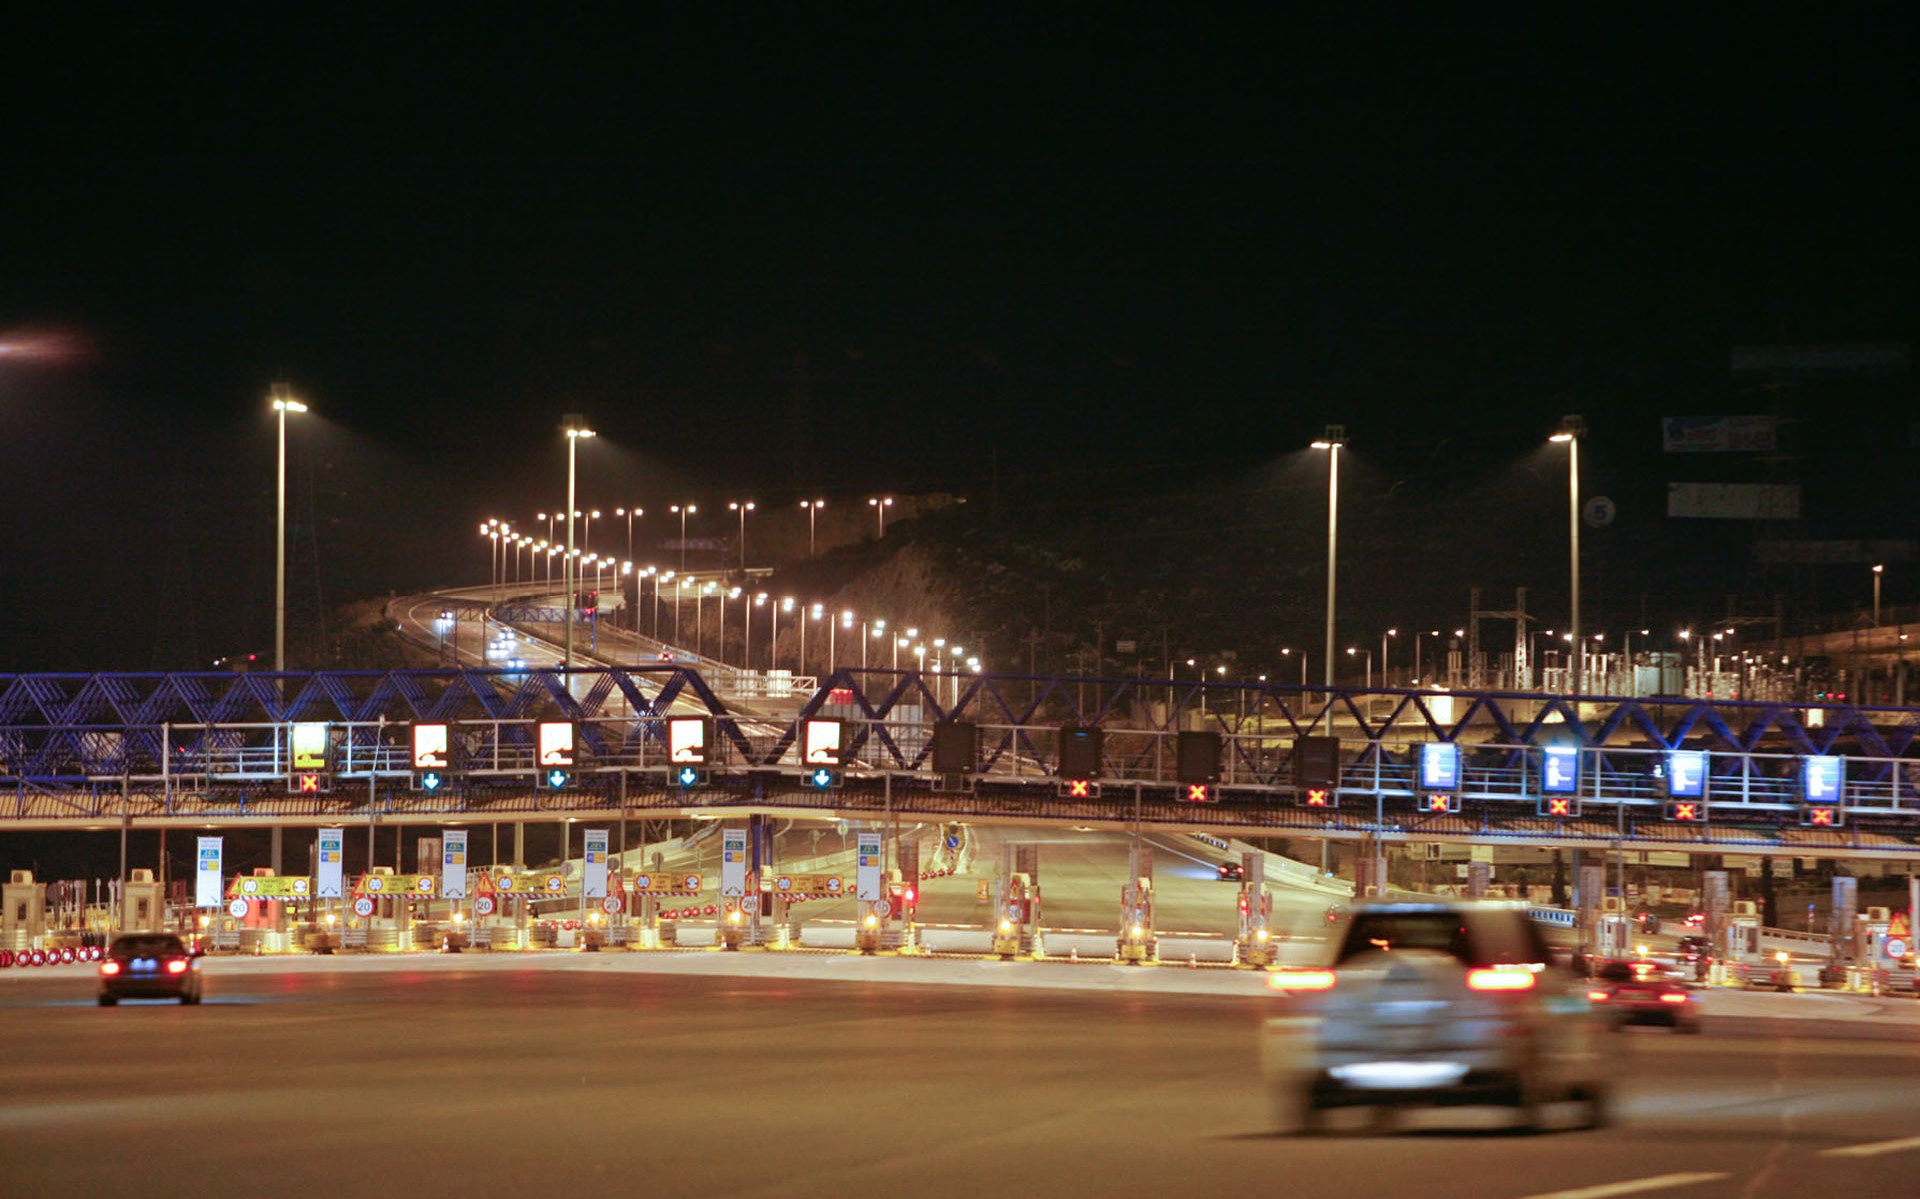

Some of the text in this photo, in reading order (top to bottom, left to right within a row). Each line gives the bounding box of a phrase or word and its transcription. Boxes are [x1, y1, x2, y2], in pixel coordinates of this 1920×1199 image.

[232, 904, 245, 913] 20
[357, 902, 370, 911] 20
[477, 901, 490, 910] 20
